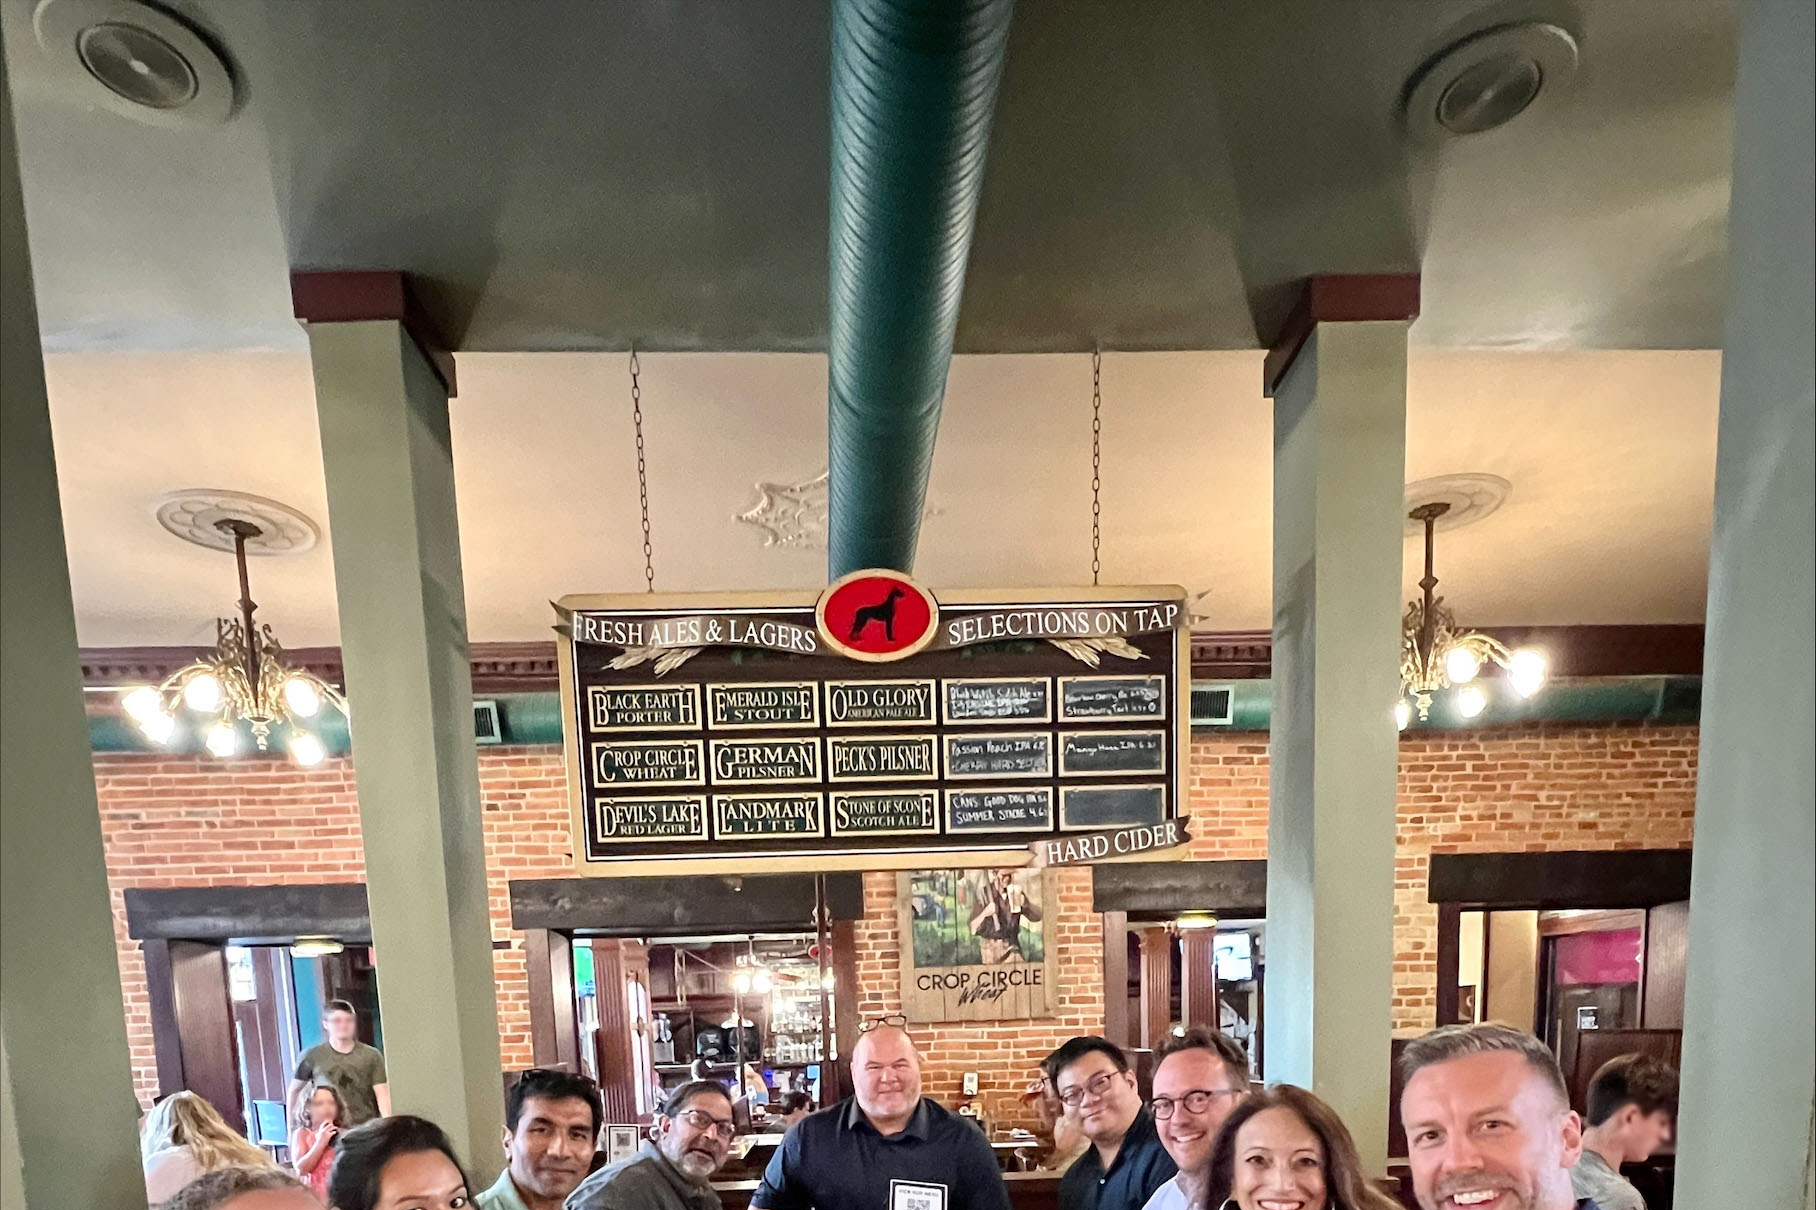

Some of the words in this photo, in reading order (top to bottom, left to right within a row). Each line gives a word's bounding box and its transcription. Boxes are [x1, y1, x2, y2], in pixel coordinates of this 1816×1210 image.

[573, 611, 643, 645] FRESH
[648, 617, 700, 645] ALES
[705, 618, 722, 642] &
[729, 619, 817, 652] LAGERS
[948, 611, 1090, 645] SELECTIONS
[1095, 611, 1128, 633] ON
[1133, 603, 1178, 630] TAP
[594, 693, 641, 726] BLACK
[645, 691, 695, 724] EARTH
[616, 711, 672, 723] PORTER
[715, 691, 778, 722] EMERALD
[782, 690, 812, 719] ISLE
[734, 708, 794, 720] STOUT
[832, 689, 868, 720] OLD
[873, 687, 929, 718] GLORY
[886, 707, 903, 717] PALE
[904, 707, 918, 717] ALE
[600, 750, 641, 781] CROP
[645, 748, 697, 779] CIRCLE
[623, 767, 677, 779] WHEAT
[717, 745, 814, 778] GERMAN
[738, 766, 795, 778] PILSNER
[834, 745, 876, 774] PECK'S
[879, 744, 930, 771] PILSNER
[602, 804, 657, 836] DEVIL'S
[662, 804, 701, 834] LAKE
[720, 801, 817, 833] LANDMARK
[743, 820, 796, 832] LITE
[837, 799, 875, 829] STONE
[877, 800, 892, 814] OF
[893, 797, 933, 826] SCONE
[850, 816, 895, 827] SCOTCH
[898, 816, 919, 827] ALE
[620, 825, 645, 835] RED
[647, 824, 686, 834] LAGER
[1047, 835, 1109, 865] HARD
[1115, 823, 1179, 853] CIDER
[917, 973, 970, 991] CROP
[977, 969, 1042, 989] CIRCLE
